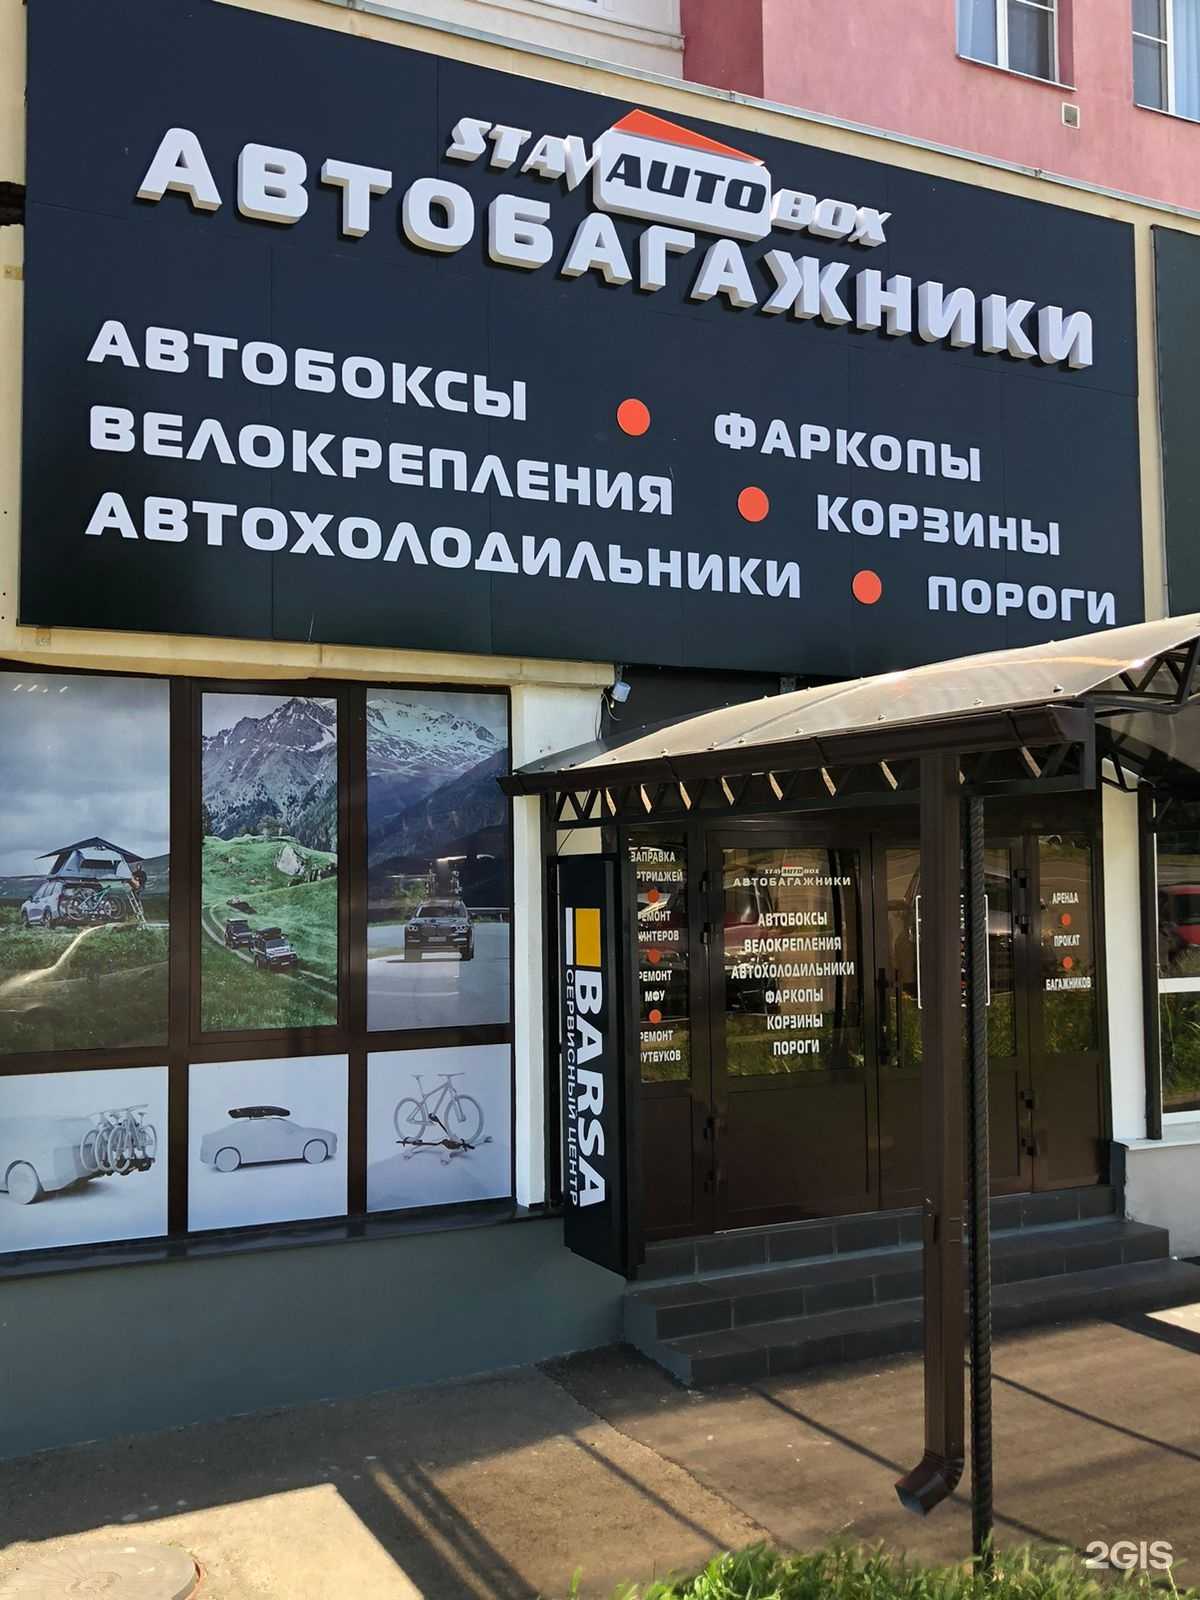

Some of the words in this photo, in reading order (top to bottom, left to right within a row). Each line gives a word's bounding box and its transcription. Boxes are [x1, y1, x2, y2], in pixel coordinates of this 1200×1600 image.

[446, 117, 600, 191] STAV
[605, 153, 768, 215] AUTO
[771, 188, 892, 247] BOX
[136, 127, 1094, 369] АВТОБАГАЖНИКИ
[87, 320, 527, 421] АВТОБОКСЫ
[713, 412, 981, 482] ФАРКОПЫ
[90, 405, 673, 516] ВЕЛОКРЕПЛЕНИЯ
[817, 494, 1060, 556] КОРЗИНЫ
[85, 492, 801, 599] АВТОХОЛОДИЛЬНИКИ
[928, 575, 1116, 625] ПОРОГИ
[630, 851, 676, 862] ЗАПРАВКА
[732, 877, 851, 887] АВТОБАГАЖНИКИ
[1052, 892, 1079, 905] АРЕНДА
[758, 912, 828, 927] АВТОБОКСЫ
[744, 937, 841, 953] ВЕЛОКРЕПЛЕНИЯ
[1054, 934, 1080, 947] ПРОКАТ
[731, 961, 855, 979] АВТОХОЛОДИЛЬНИКИ
[1045, 977, 1091, 991] БАГАЖНИКОВ
[644, 990, 665, 1002] МФУ
[765, 988, 824, 1004] ФАРКОПЫ
[767, 1014, 823, 1030] КОРЗИНЫ
[566, 969, 577, 1119] СЕРВИСНЫЙ
[773, 1039, 820, 1056] ПОРОГИ
[640, 1049, 681, 1063] УТБУКОВ
[575, 970, 606, 1208] BARSA
[568, 1127, 578, 1207] ЦЕНТР
